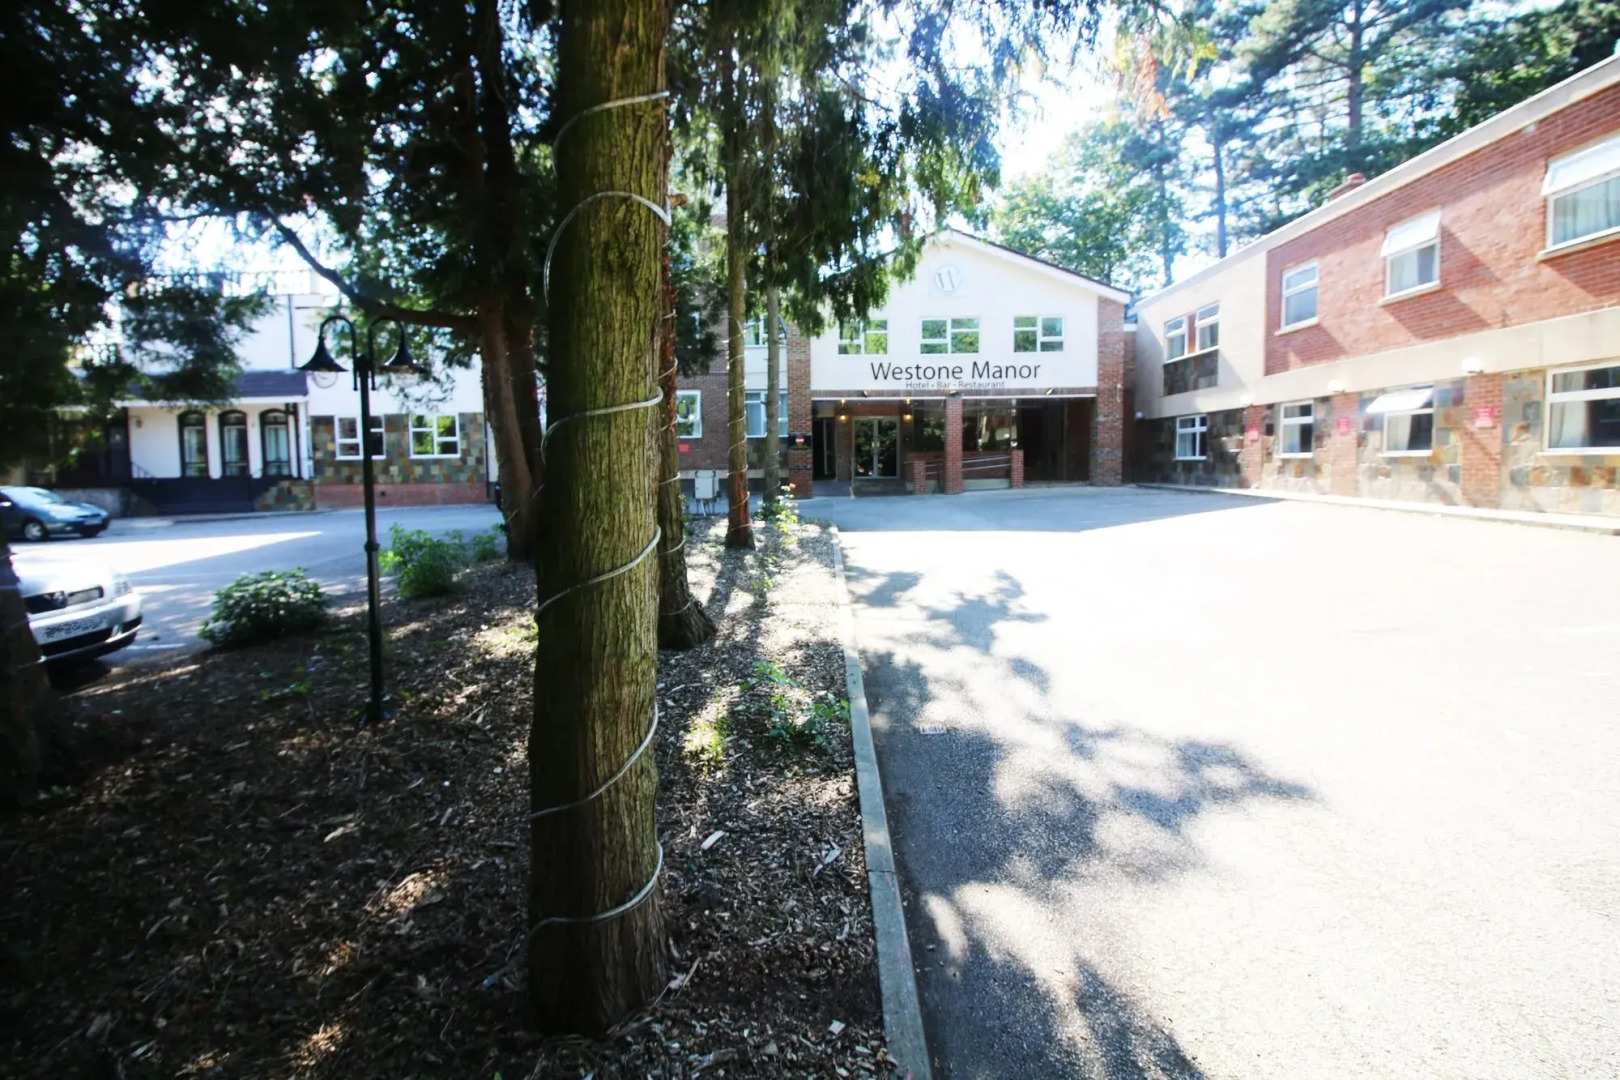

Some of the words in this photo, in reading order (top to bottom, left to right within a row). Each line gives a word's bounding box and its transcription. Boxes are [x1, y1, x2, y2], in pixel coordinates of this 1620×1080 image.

[870, 362, 963, 380] Westone
[971, 361, 1041, 379] Manor
[905, 381, 930, 389] Hotel
[936, 381, 951, 389] Bar
[958, 381, 1005, 389] Restaurant
